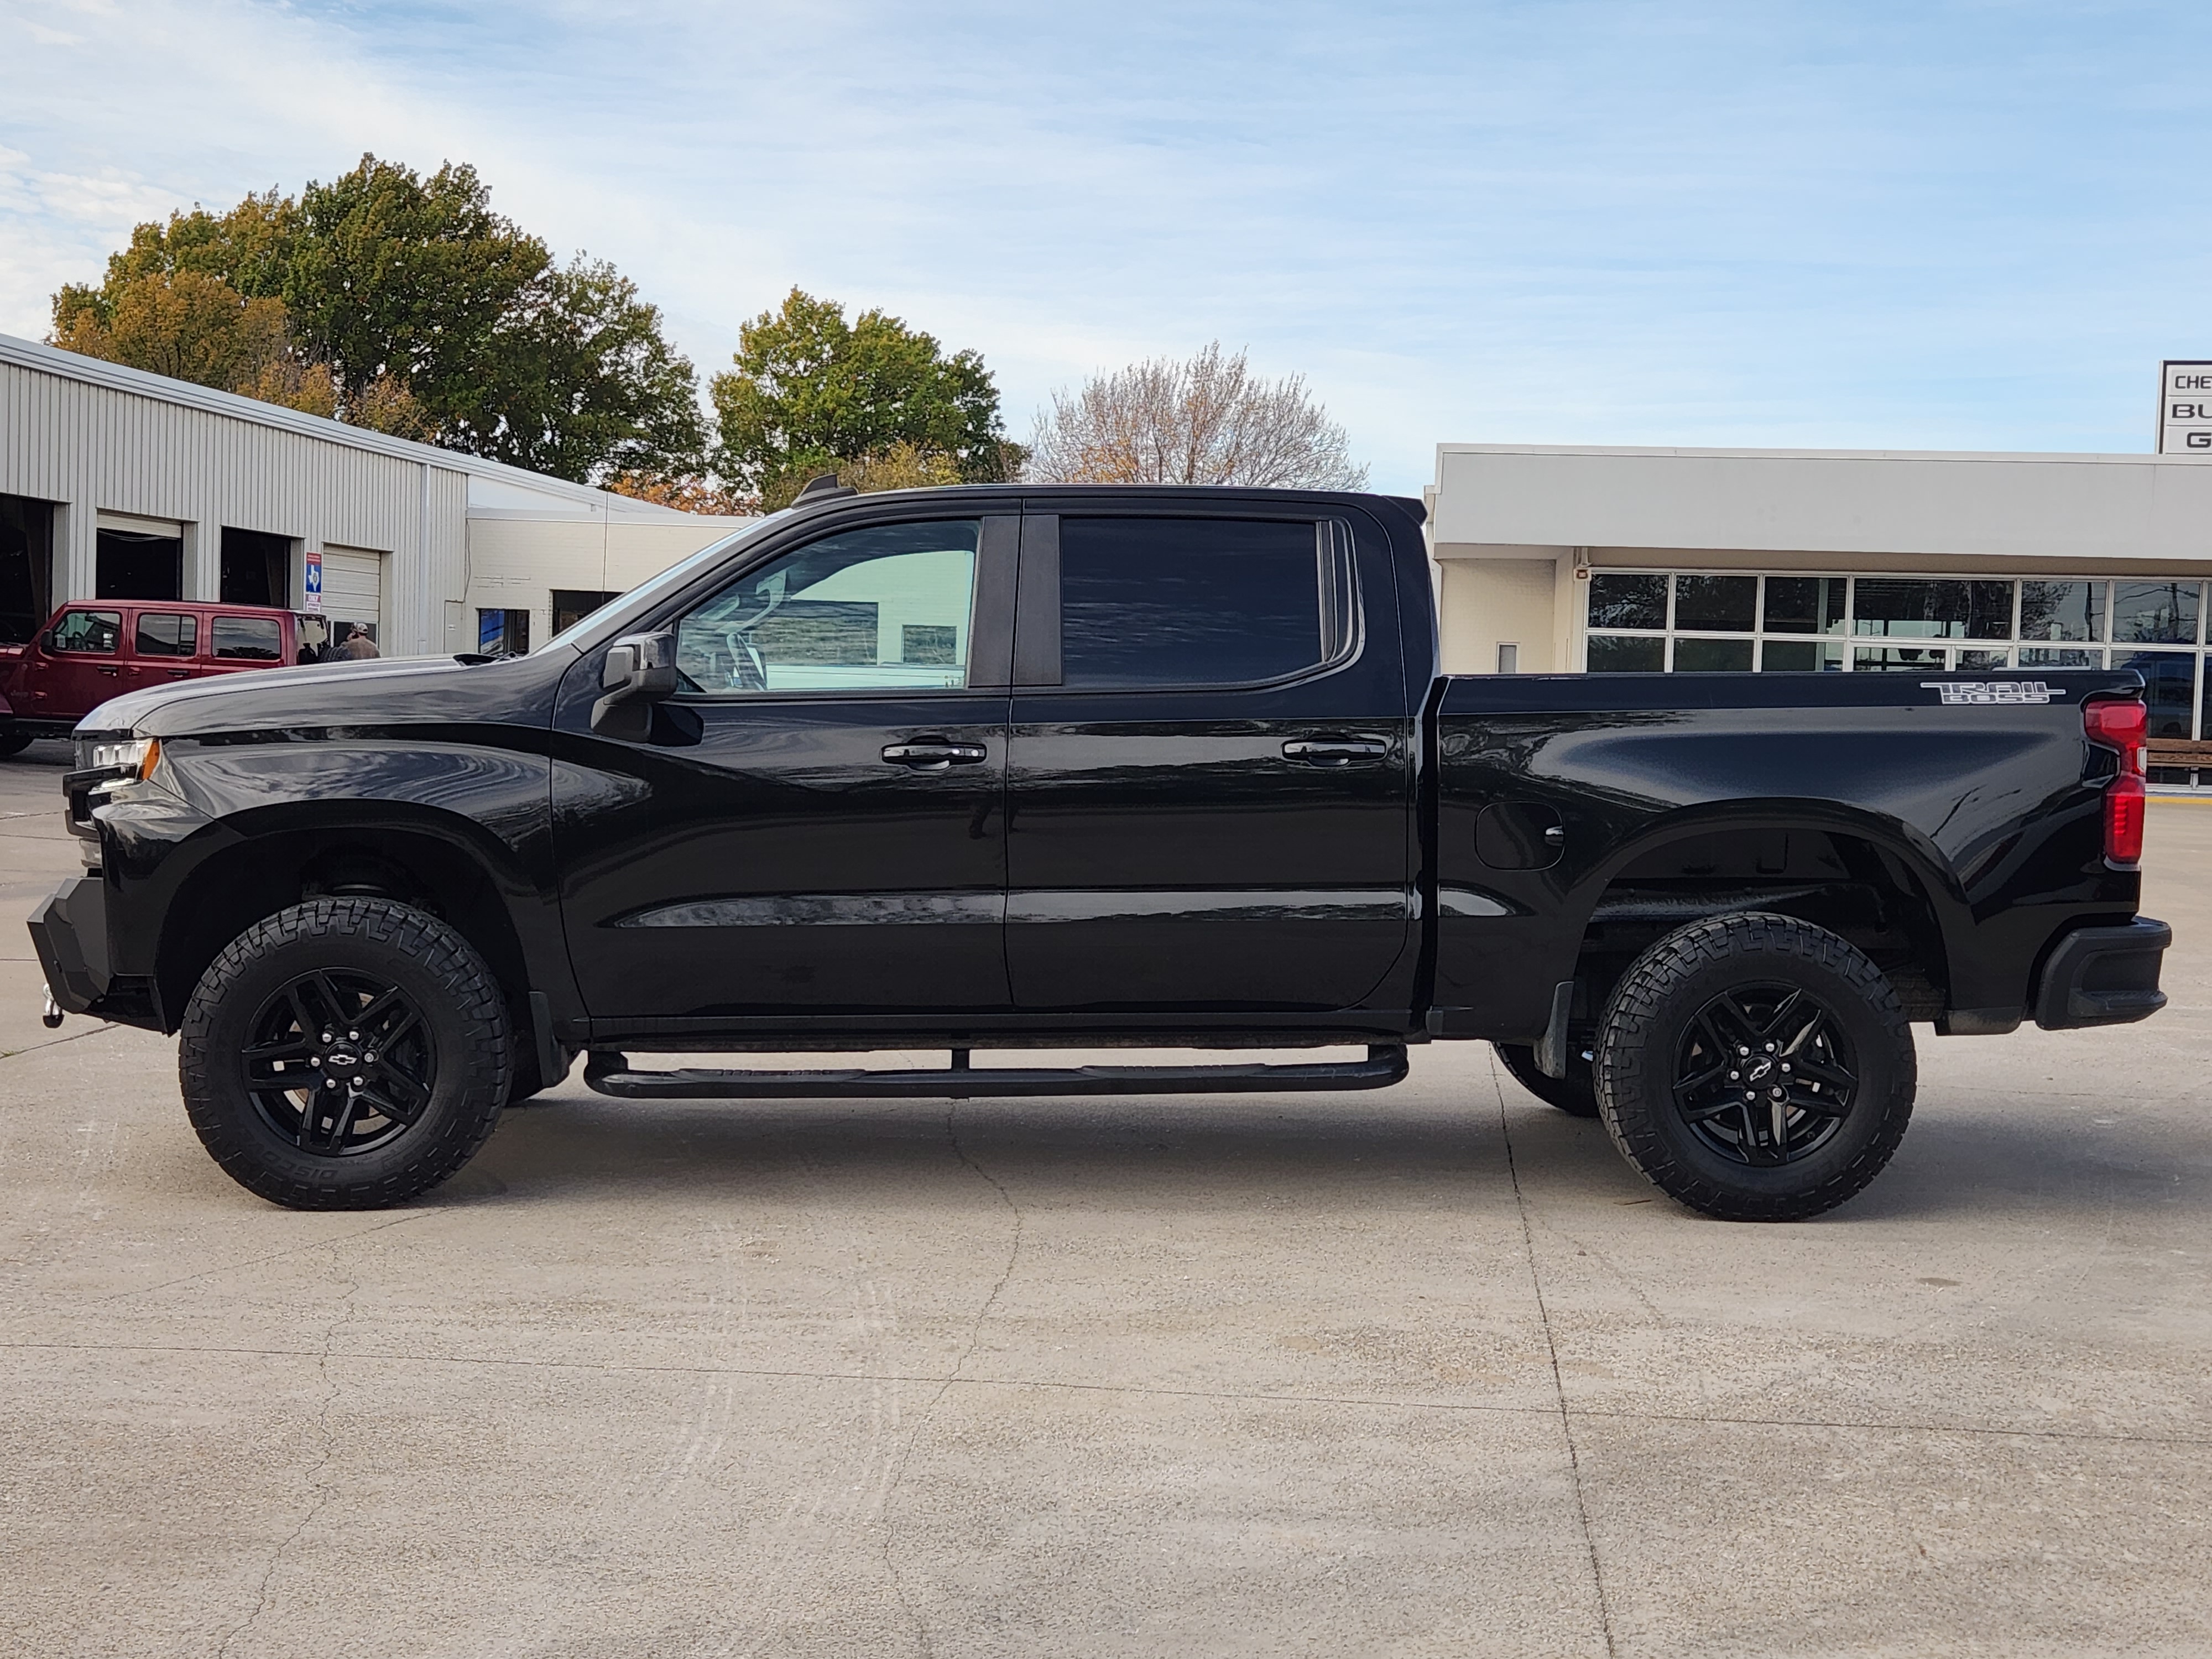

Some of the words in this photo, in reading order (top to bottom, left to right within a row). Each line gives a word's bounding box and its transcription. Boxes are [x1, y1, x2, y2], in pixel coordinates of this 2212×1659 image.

[2175, 375, 2212, 389] CHE
[2187, 432, 2212, 448] G
[1920, 682, 2066, 695] TRAIL
[1942, 693, 2050, 705] BOSS
